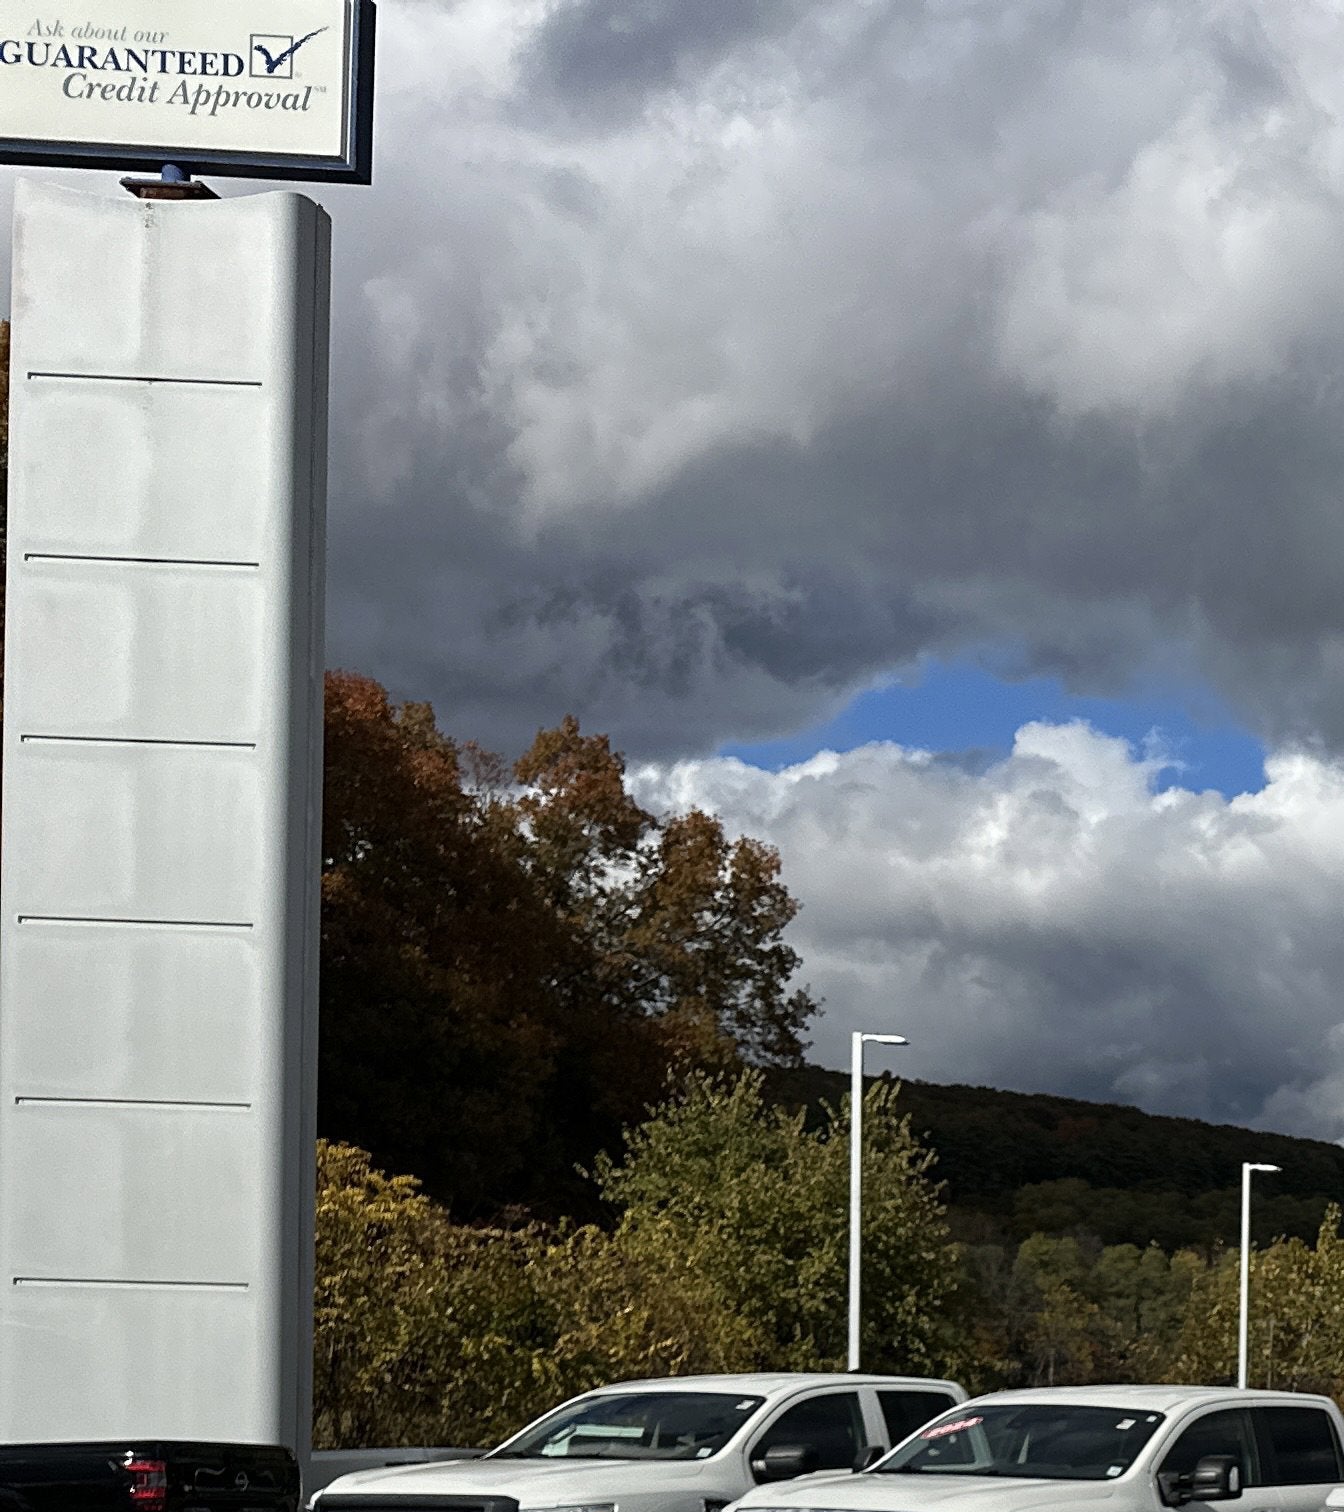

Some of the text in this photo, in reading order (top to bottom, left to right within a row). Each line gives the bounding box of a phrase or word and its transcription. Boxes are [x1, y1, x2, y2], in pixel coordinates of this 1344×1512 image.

[27, 18, 169, 44] Ask about our
[0, 39, 245, 78] GUARANTEED
[62, 72, 159, 104] Credit
[166, 78, 313, 117] Approval
